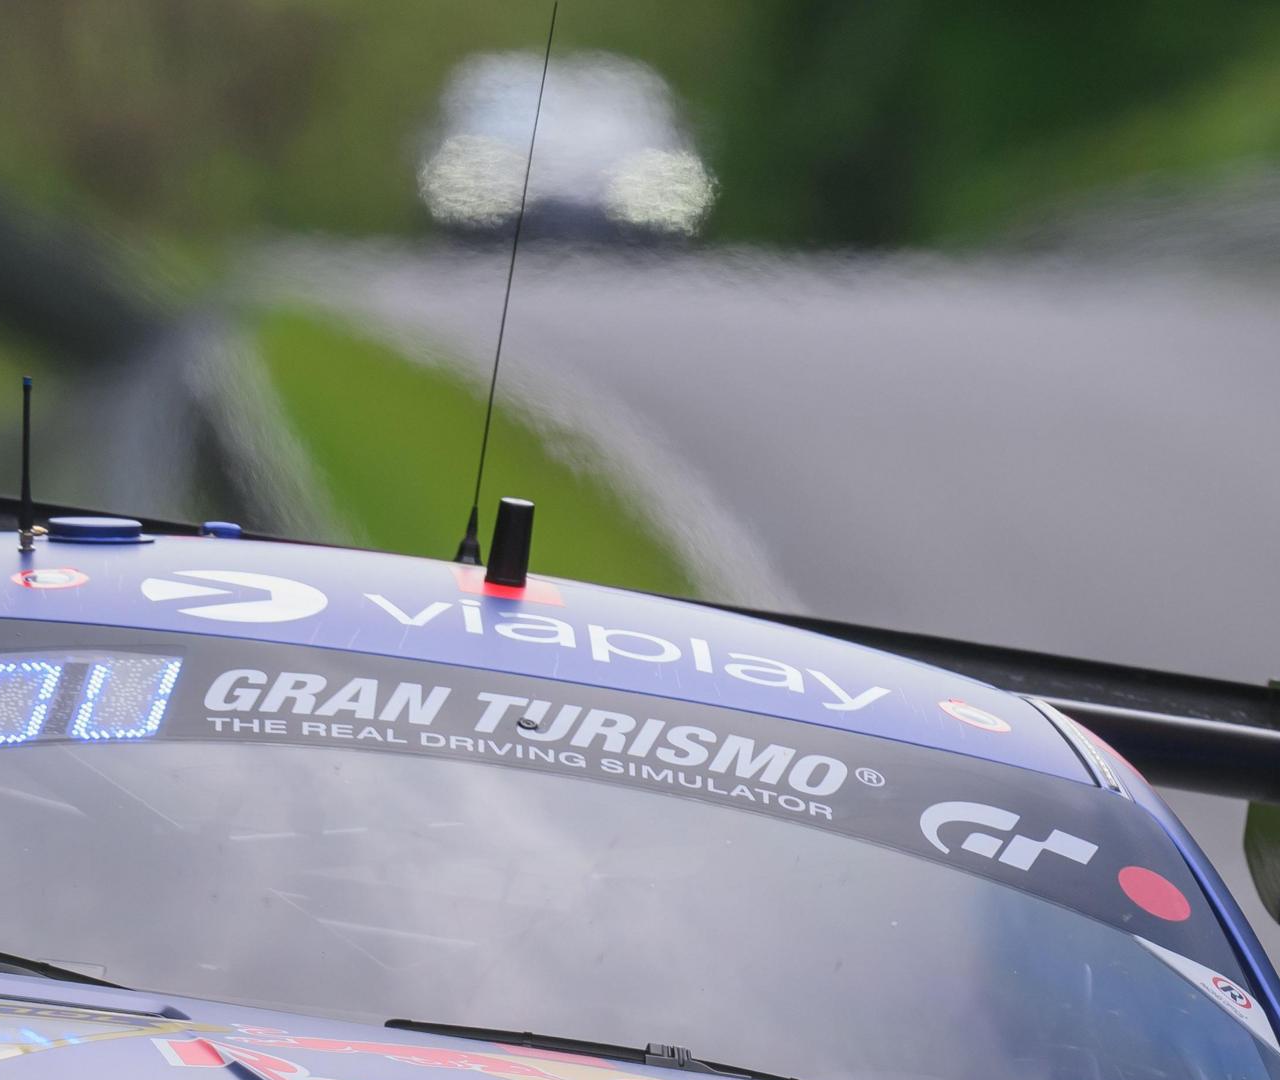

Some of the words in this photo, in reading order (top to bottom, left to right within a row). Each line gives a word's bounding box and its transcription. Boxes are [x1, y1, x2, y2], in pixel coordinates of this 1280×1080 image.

[203, 668, 452, 725] GRAN
[363, 592, 891, 711] viaplay
[206, 716, 287, 735] THE
[302, 720, 408, 744] REAL
[421, 731, 587, 767] DRIVING
[600, 757, 834, 820] SIMULATOR
